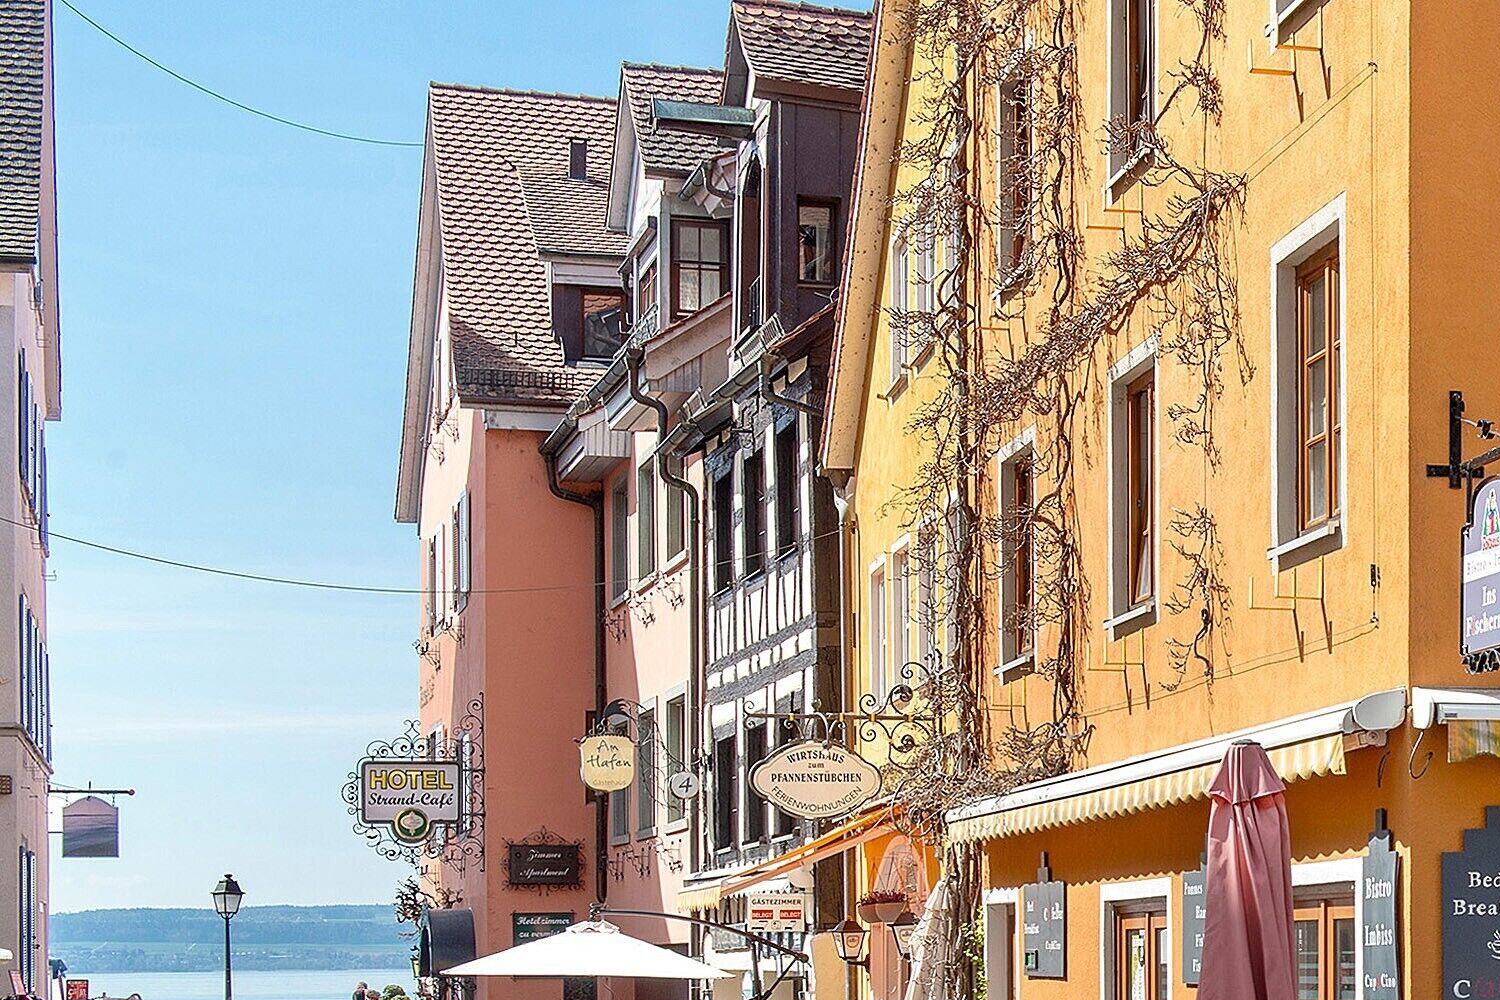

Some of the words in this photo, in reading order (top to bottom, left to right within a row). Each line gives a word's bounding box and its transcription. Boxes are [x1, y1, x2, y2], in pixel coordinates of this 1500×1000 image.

[1482, 585, 1497, 607] Ins
[587, 753, 631, 770] Hafen
[369, 769, 454, 790] HOTEL
[679, 777, 692, 793] 4
[367, 792, 453, 808] Strand-Café
[771, 786, 862, 812] FERIENWOHNUNGEN
[527, 849, 562, 861] Zimmer
[519, 867, 570, 880] Apartment
[1365, 876, 1392, 900] Bistro
[1364, 923, 1393, 946] Imbiss
